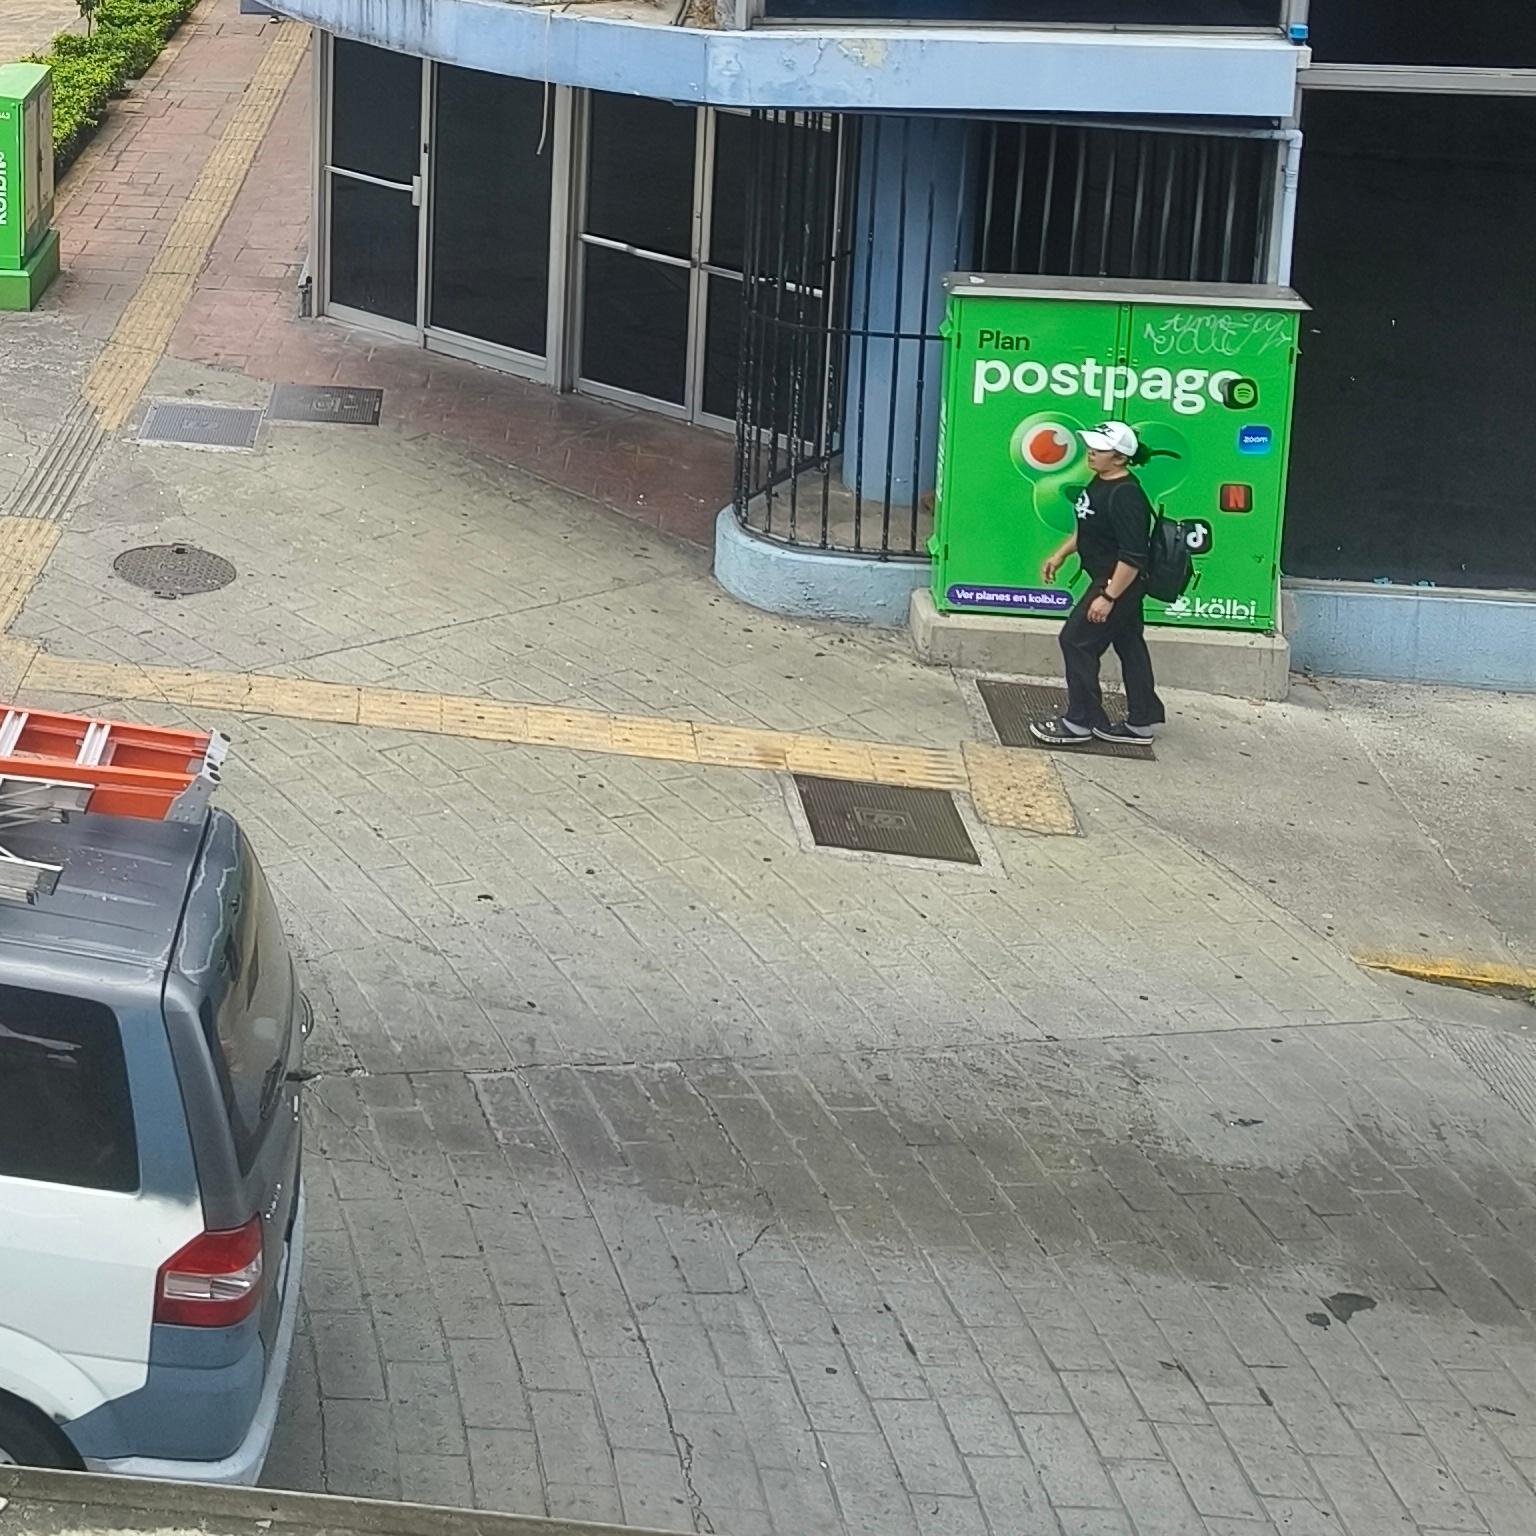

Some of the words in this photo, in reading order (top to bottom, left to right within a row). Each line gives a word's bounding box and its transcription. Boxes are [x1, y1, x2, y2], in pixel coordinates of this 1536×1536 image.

[978, 329, 1031, 351] Plan
[972, 356, 1244, 416] postpago
[1243, 435, 1269, 444] zoom
[1229, 485, 1245, 509] N
[955, 589, 974, 600] Ver
[976, 590, 1011, 602] planes
[1013, 594, 1027, 603] en
[1195, 597, 1256, 622] kölbi
